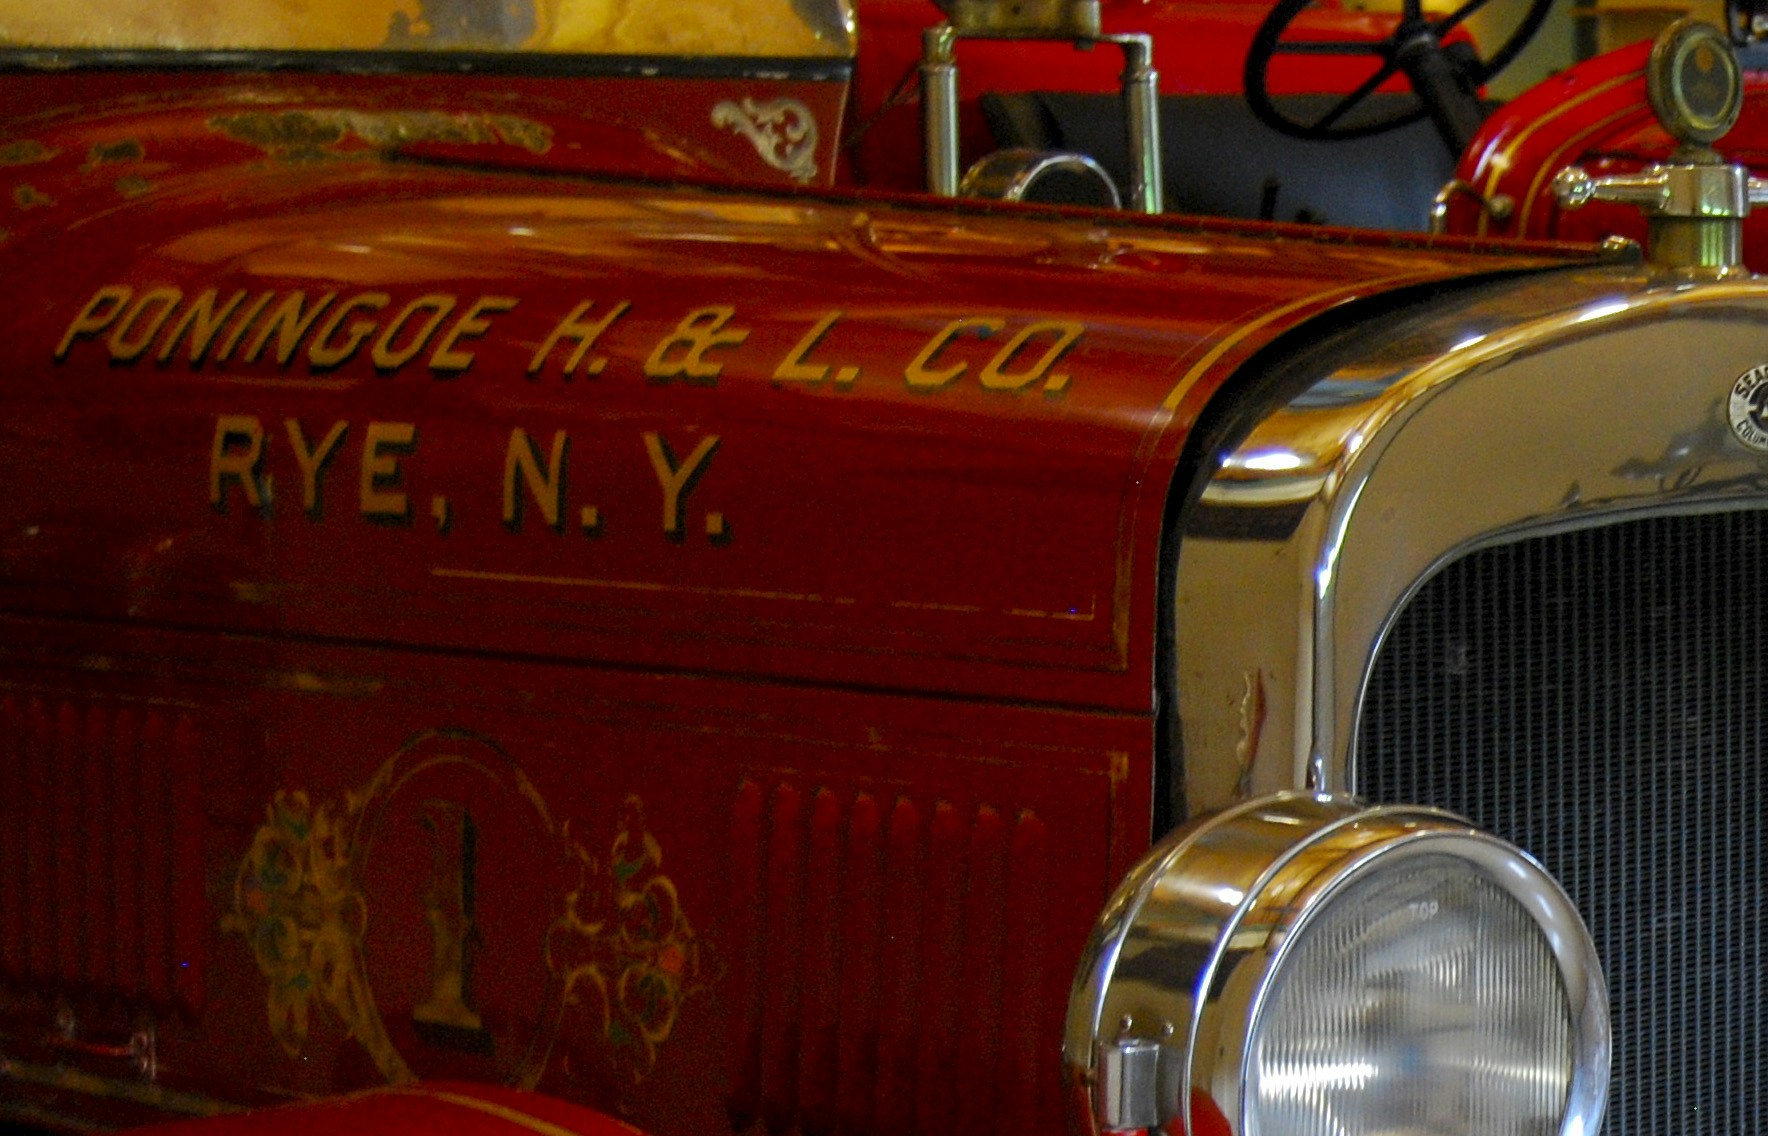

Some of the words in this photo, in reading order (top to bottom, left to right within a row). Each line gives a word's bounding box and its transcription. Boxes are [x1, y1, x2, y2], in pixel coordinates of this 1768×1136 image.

[53, 284, 520, 373] PONINGOE
[525, 300, 632, 376] H.
[643, 305, 752, 385] &
[772, 310, 862, 388] L.
[904, 316, 1086, 394] CO.
[210, 414, 448, 533] RYE,
[502, 426, 602, 532] N.
[641, 432, 728, 542] Y.
[1408, 901, 1439, 921] TOP
